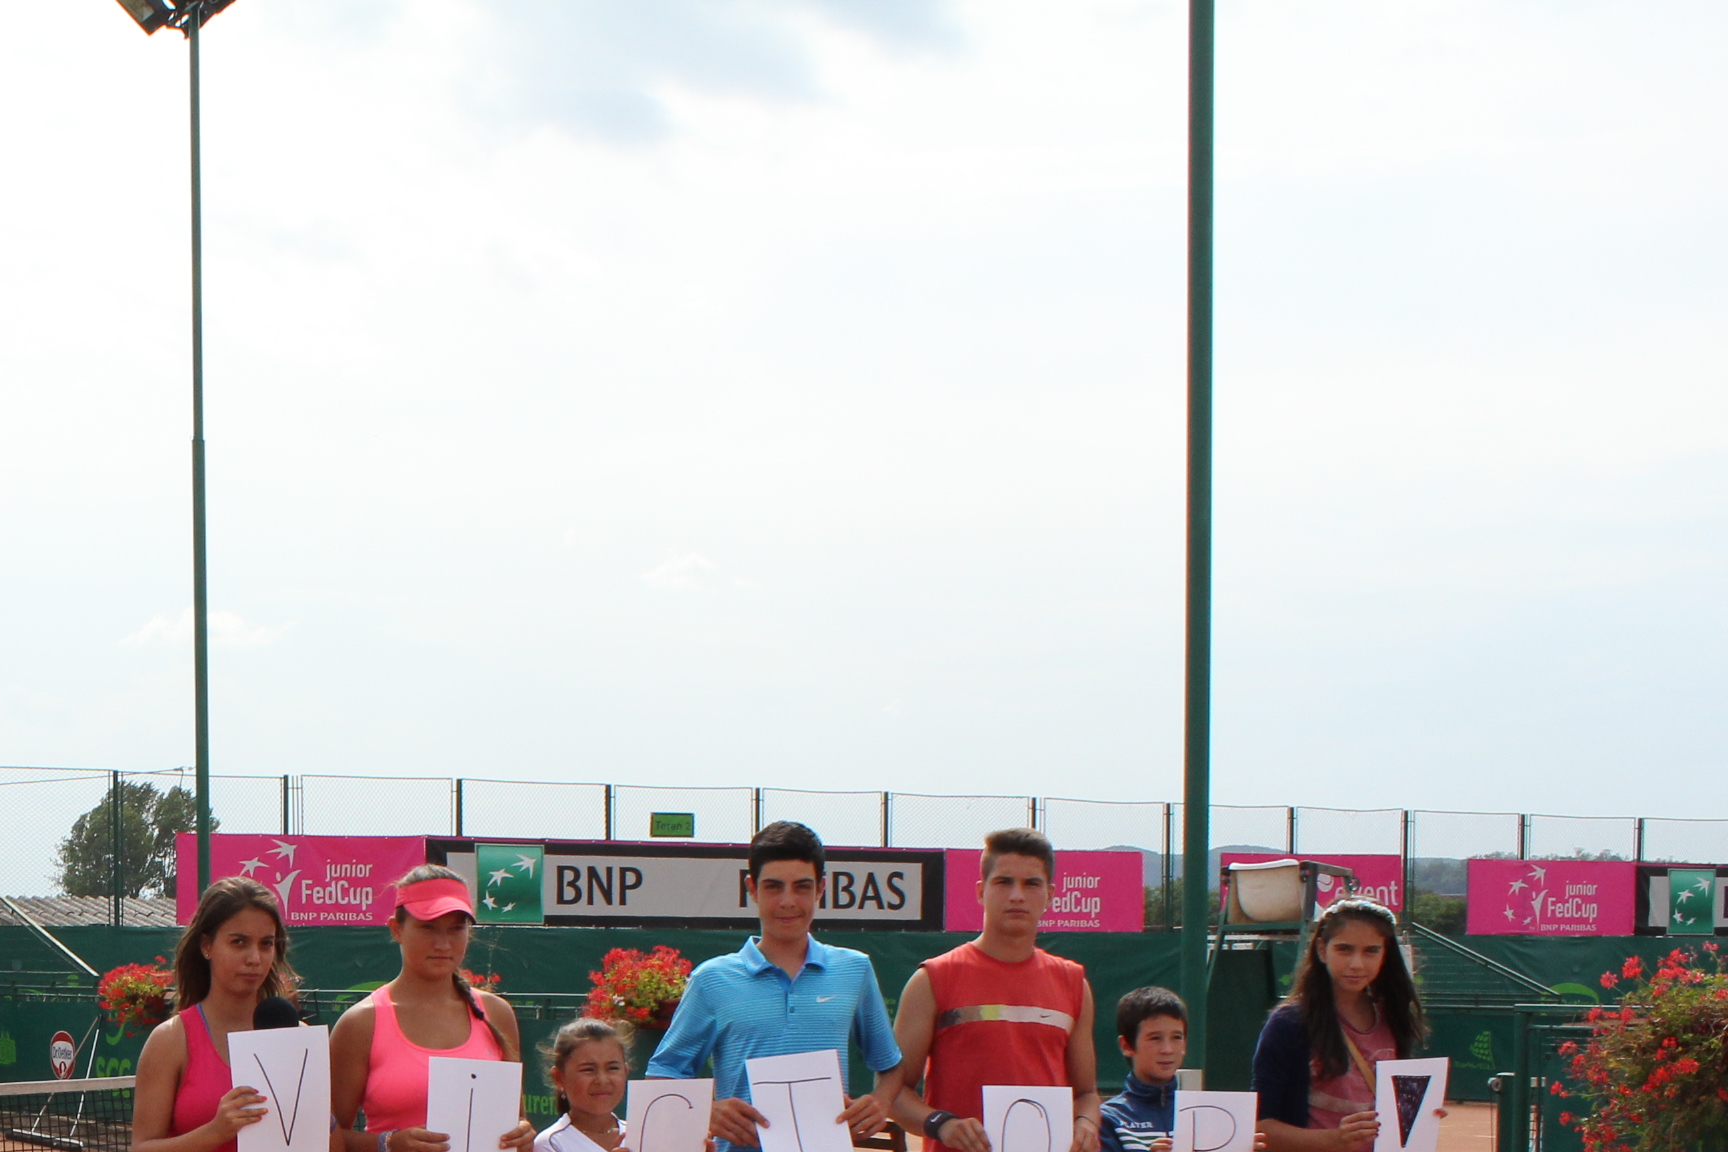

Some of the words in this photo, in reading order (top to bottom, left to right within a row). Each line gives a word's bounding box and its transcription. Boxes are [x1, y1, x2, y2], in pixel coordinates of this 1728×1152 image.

[325, 859, 373, 882] junior
[1062, 872, 1101, 892] junior
[300, 879, 373, 911] FedCup
[555, 864, 644, 906] BNP
[1564, 880, 1598, 899] junior
[1044, 890, 1101, 918] edCup
[1547, 897, 1598, 923] FedCup
[291, 912, 317, 921] BNP
[320, 912, 373, 921] PARIBAS
[1057, 919, 1101, 928] PARIBAS
[253, 1048, 309, 1147] V
